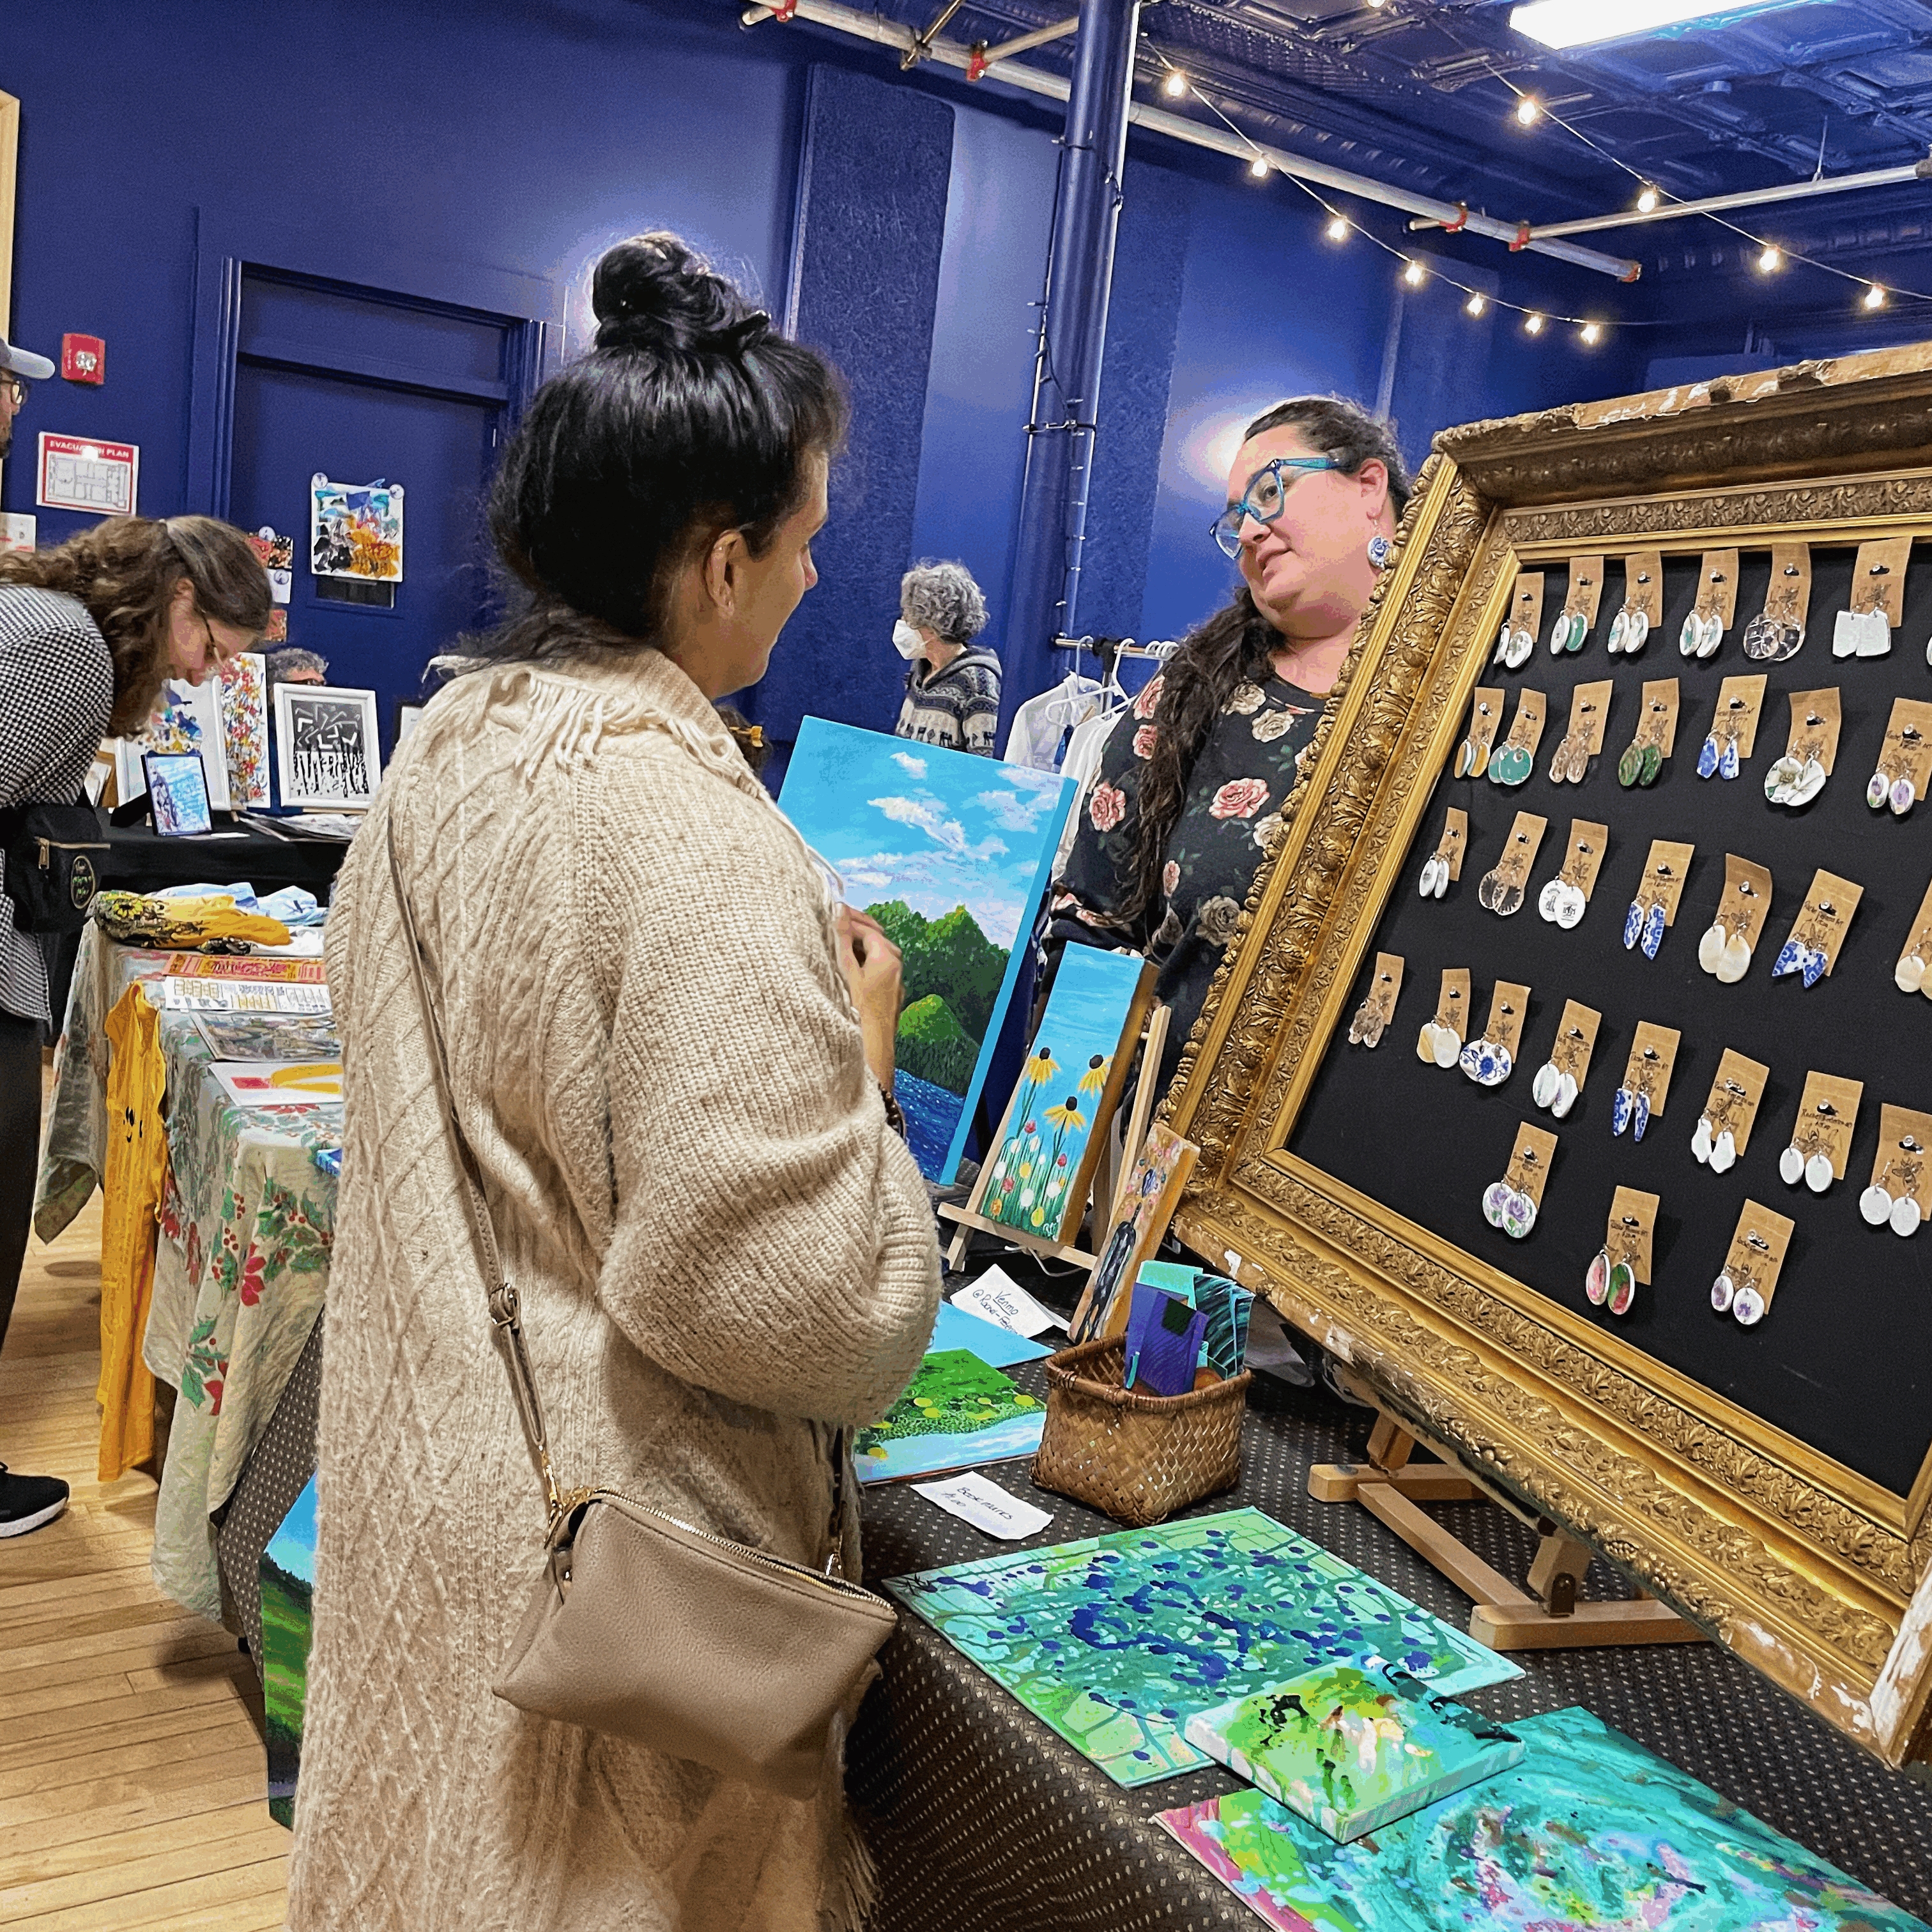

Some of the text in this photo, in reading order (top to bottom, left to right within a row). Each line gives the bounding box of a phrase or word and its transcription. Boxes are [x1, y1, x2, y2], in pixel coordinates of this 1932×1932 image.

[50, 440, 130, 459] EVACUN PLAN
[995, 1291, 1019, 1315] Venmo
